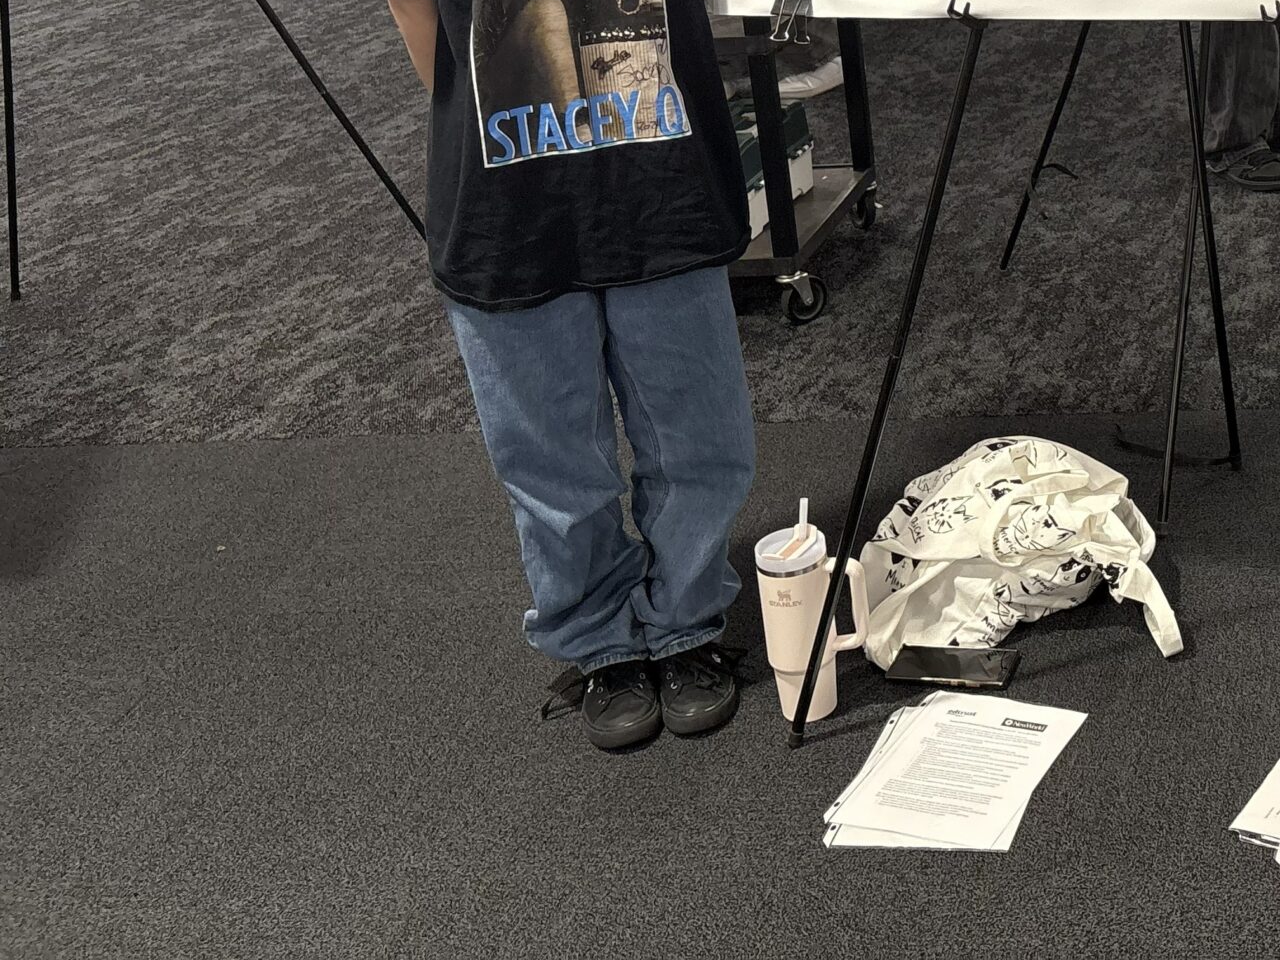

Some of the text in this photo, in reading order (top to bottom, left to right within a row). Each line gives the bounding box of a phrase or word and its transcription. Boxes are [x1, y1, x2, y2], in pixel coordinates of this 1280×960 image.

[487, 85, 691, 164] STACEY Q
[769, 600, 802, 608] STANLEY
